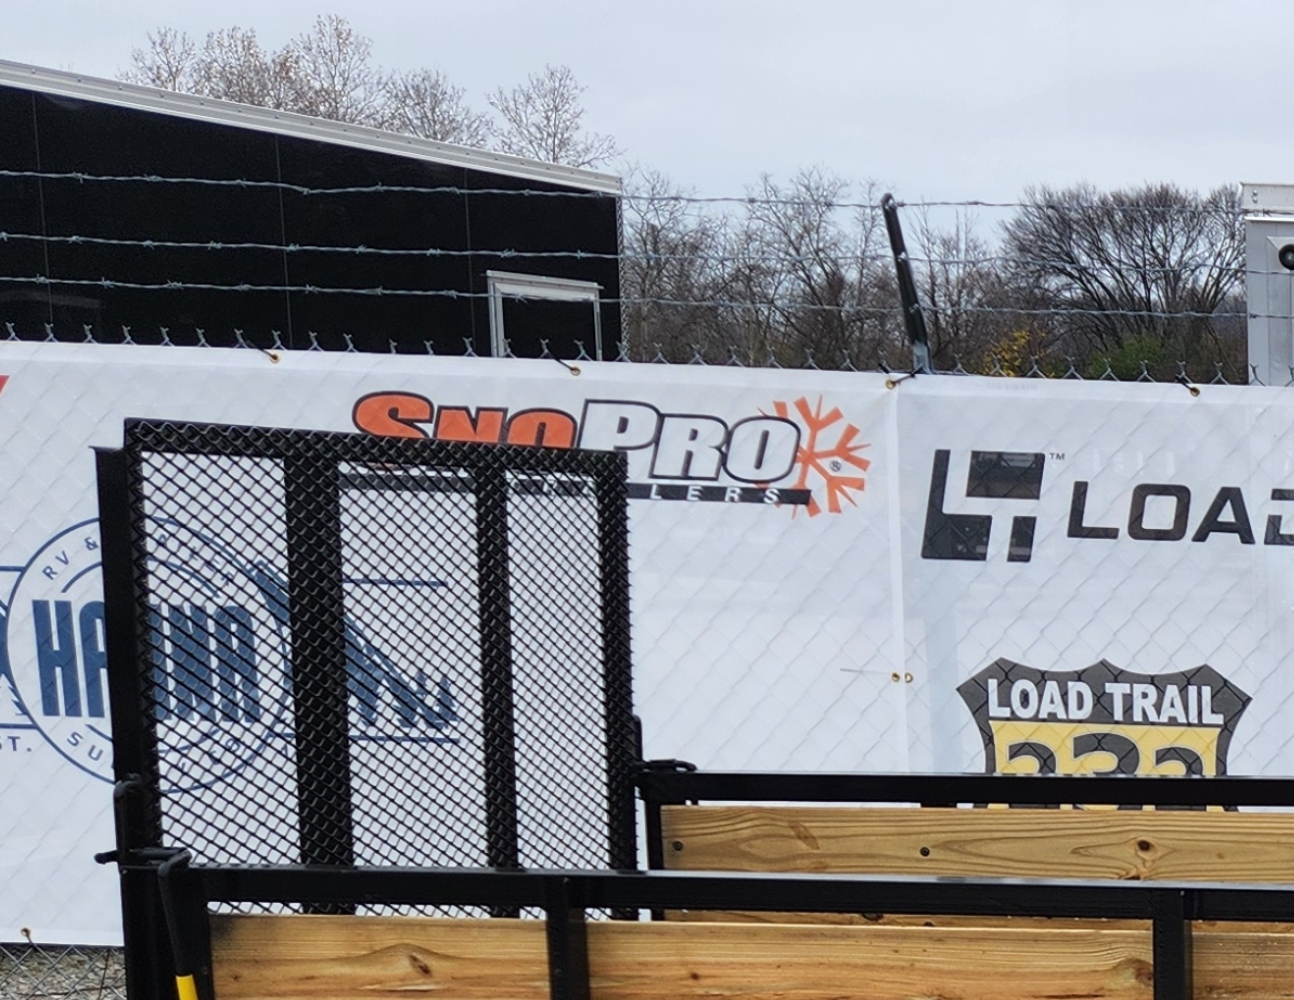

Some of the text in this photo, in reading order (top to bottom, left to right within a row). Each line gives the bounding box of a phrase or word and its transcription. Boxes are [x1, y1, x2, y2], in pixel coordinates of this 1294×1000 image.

[42, 550, 69, 580] RV
[84, 536, 99, 551] &
[987, 678, 1225, 725] LOAD TRAIL
